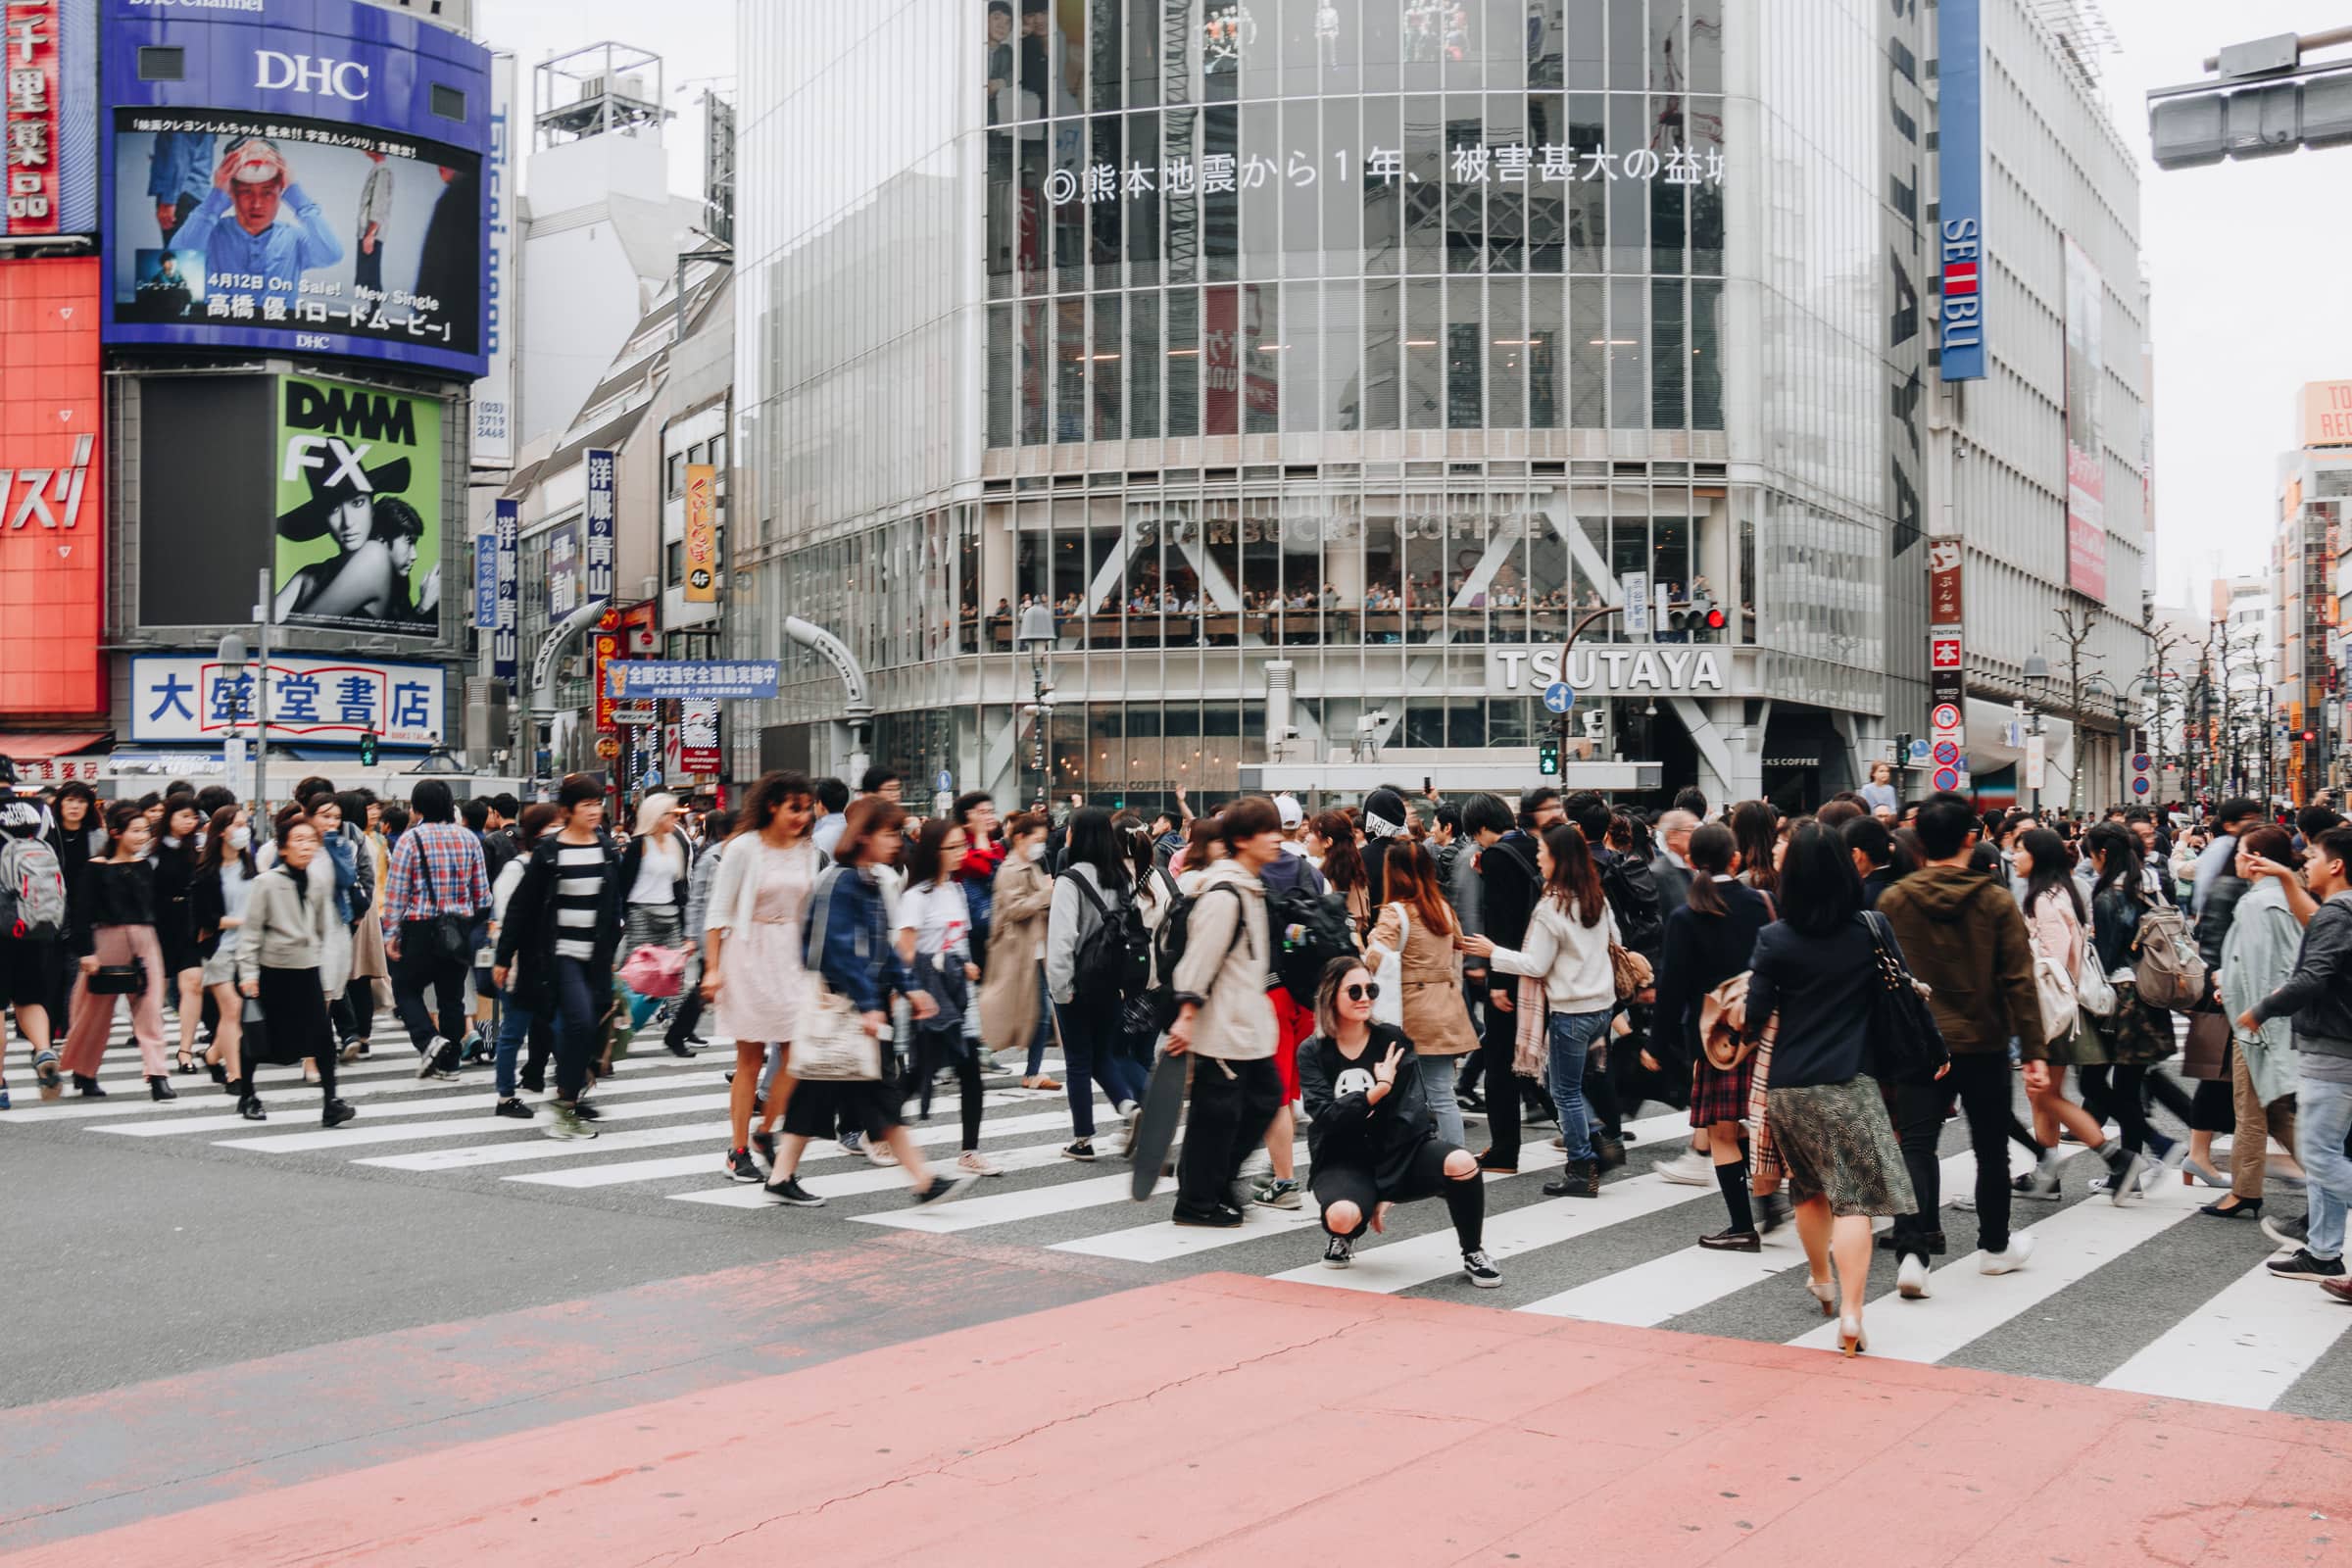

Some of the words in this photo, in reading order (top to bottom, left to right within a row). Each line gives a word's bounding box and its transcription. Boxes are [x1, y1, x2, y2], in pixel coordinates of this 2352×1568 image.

[254, 50, 368, 101] DHC
[7, 0, 48, 218] 千里薬品
[208, 273, 264, 291] 4月12日
[269, 276, 293, 292] On
[298, 279, 342, 298] Sale!
[354, 284, 389, 303] New
[392, 288, 440, 312] Single
[1942, 218, 1979, 351] SEIBU
[296, 334, 329, 350] DHC
[286, 380, 416, 447] DMM
[282, 434, 373, 492] FX
[588, 458, 613, 596] 洋服の青山
[1136, 516, 1369, 548] STARBUCKS
[1394, 512, 1543, 540] COFFEE
[496, 516, 517, 662] 洋服の青山
[690, 571, 710, 588] 4F
[1496, 649, 1724, 690] TSUTAYA
[1936, 643, 1958, 664] 本
[150, 672, 430, 728] 大盛堂書店
[1781, 758, 1820, 766] COFFEE
[1129, 780, 1176, 791] COFFEE
